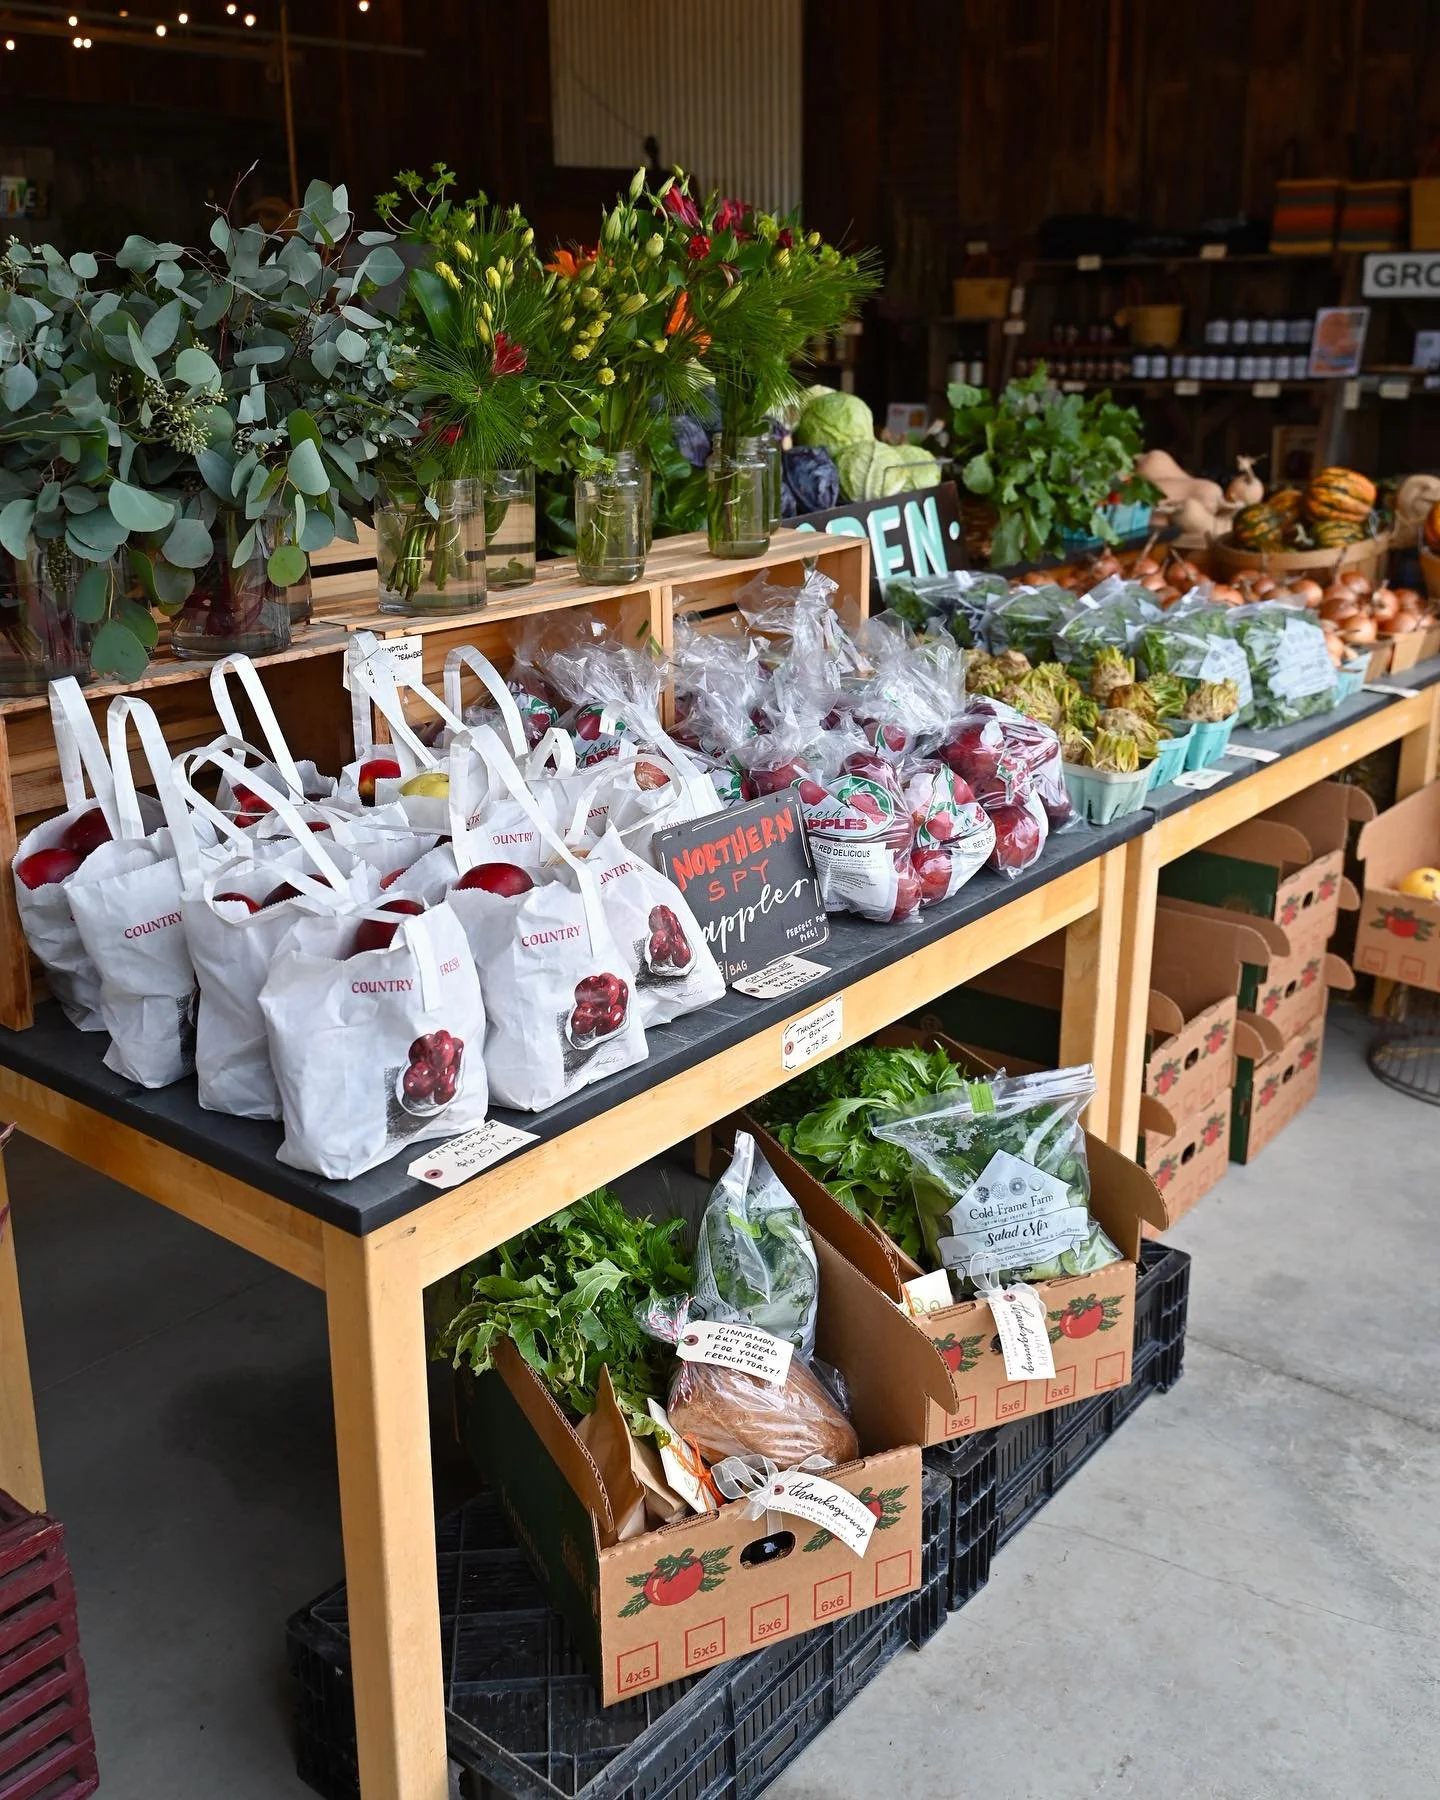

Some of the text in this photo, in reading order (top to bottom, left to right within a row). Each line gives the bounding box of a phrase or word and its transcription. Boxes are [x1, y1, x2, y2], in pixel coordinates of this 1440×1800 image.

[807, 818, 868, 831] PPLES
[492, 831, 535, 845] OUNTRY
[672, 807, 794, 893] NORTHERN
[818, 844, 832, 856] RED
[832, 847, 871, 859] DELICIOUS
[707, 858, 769, 902] SPY
[124, 911, 183, 939] COUNTRY
[702, 879, 809, 953] apples
[521, 925, 581, 947] COUNTRY
[351, 979, 414, 994] COUNTRY
[427, 1121, 499, 1160] ENTERPRISE
[454, 1133, 496, 1157] APPLES
[969, 1194, 1054, 1220] Cold Frame Farm
[985, 1223, 1019, 1248] Salad
[1023, 1219, 1049, 1238] Mix
[707, 1334, 778, 1356] FRUIT BREAD
[718, 1327, 775, 1347] CINNAMON
[704, 1351, 780, 1377] FRENCH TOAST!
[713, 1344, 765, 1362] FOR YOUR
[951, 1385, 1070, 1430] 5x5 5x6 6x6
[625, 1595, 844, 1684] 4x5 5x5 5x6 6x6
